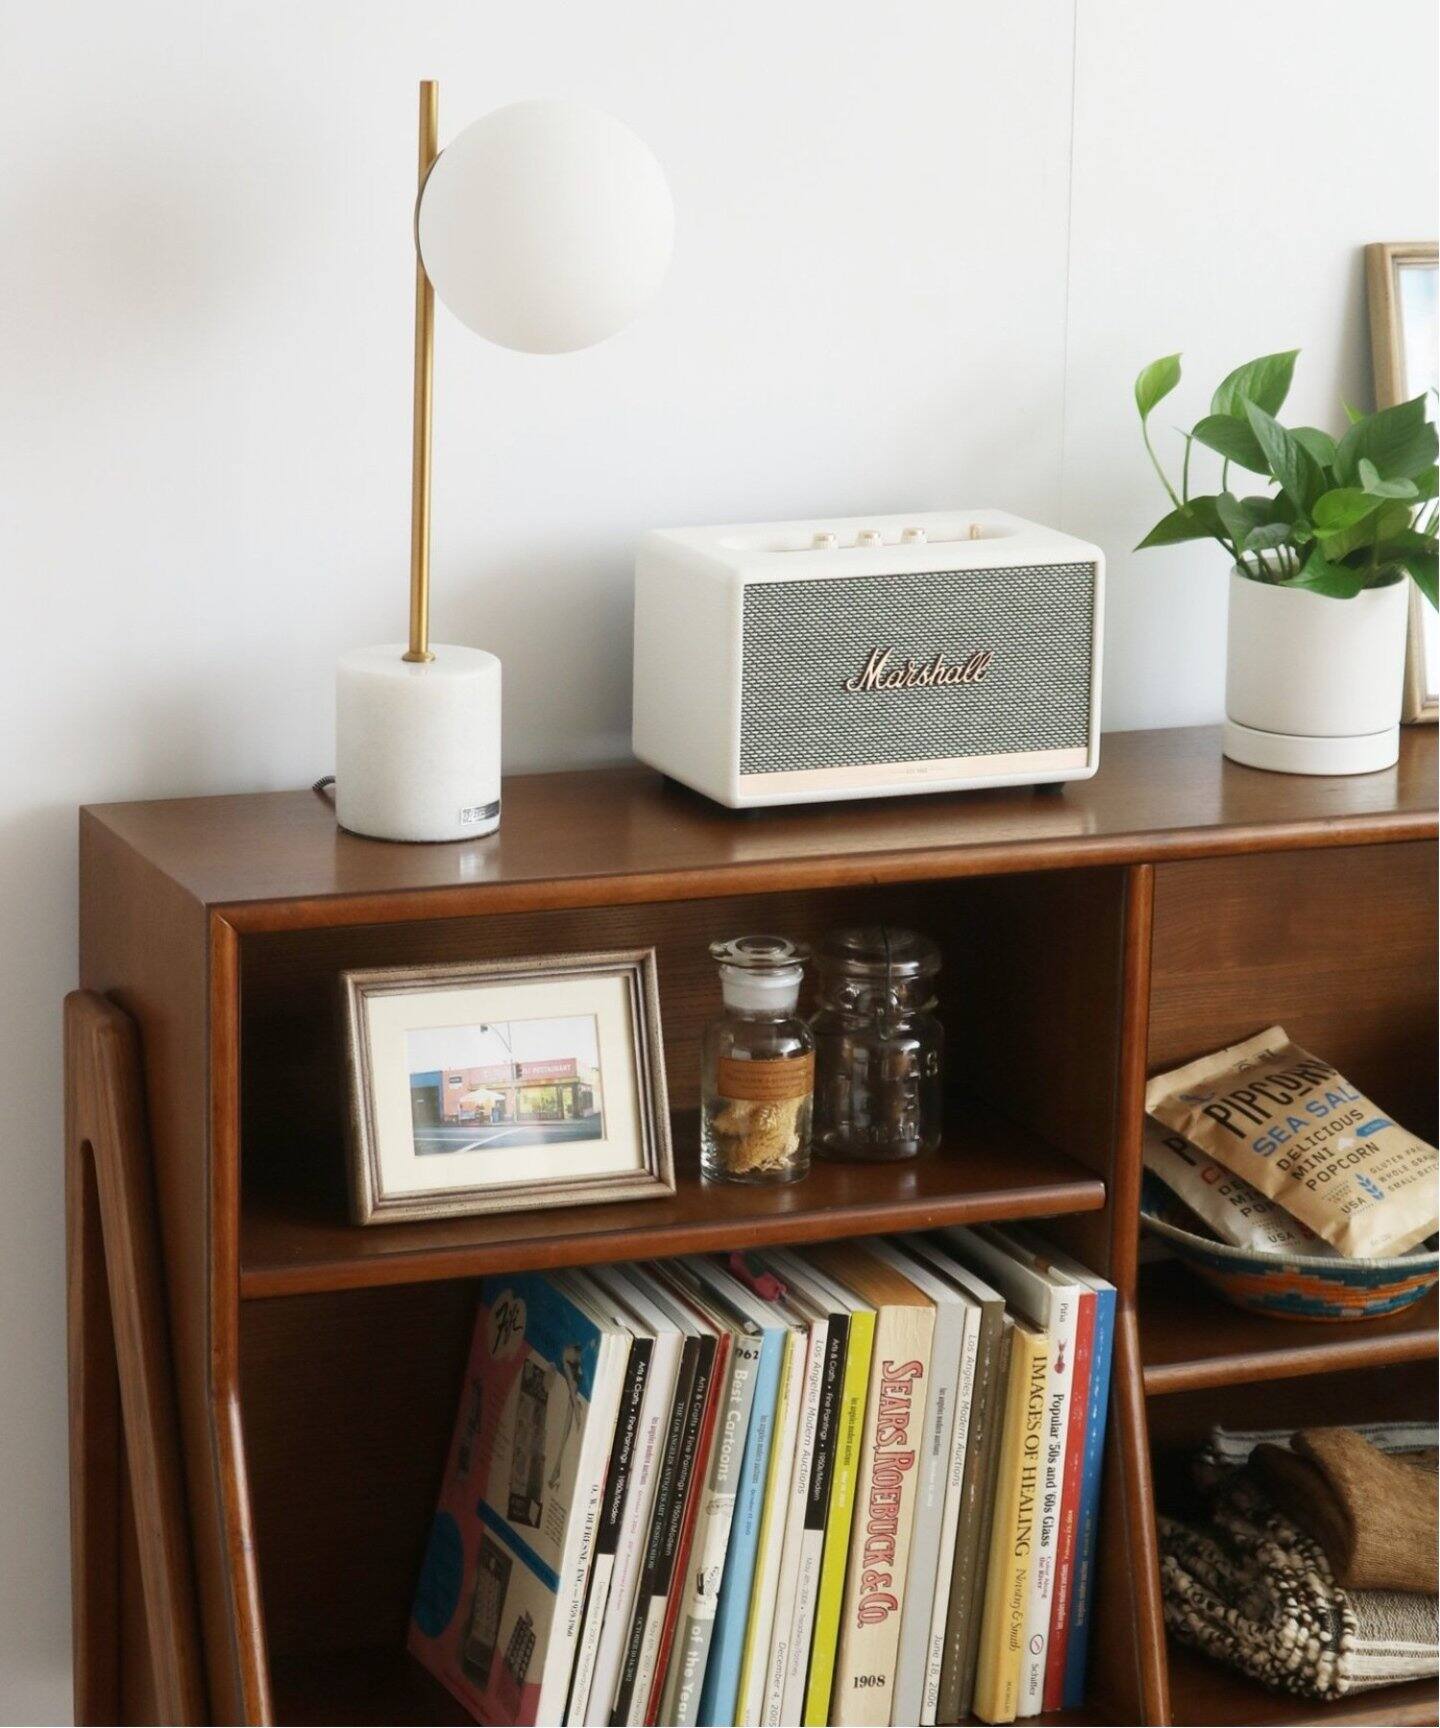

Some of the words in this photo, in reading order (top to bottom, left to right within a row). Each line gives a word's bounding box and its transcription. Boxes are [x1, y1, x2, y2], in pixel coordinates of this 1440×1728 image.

[846, 646, 994, 692] Marshall
[1202, 1059, 1337, 1139] PIPCORN
[1252, 1115, 1310, 1157] SEA
[1305, 1083, 1361, 1118] SAL
[1276, 1109, 1364, 1171] DELICIOUS
[1291, 1147, 1335, 1180] MINI
[1306, 1142, 1380, 1191] POPCORN
[1341, 1196, 1367, 1214] USA
[1268, 1231, 1296, 1244] USA
[814, 1341, 823, 1356] Los
[830, 1339, 838, 1350] Arts
[967, 1335, 976, 1351] Los
[637, 1362, 646, 1374] Arts
[807, 1363, 820, 1401] Angeles
[828, 1361, 836, 1381] Crafts
[961, 1356, 974, 1396] Angeles
[631, 1384, 642, 1404] Crafts
[697, 1376, 706, 1391] Arts
[730, 1370, 747, 1402] Best
[1026, 1356, 1048, 1432] IMAGES
[690, 1402, 701, 1426] Crafts
[824, 1393, 832, 1406] Fine
[627, 1416, 636, 1429] Fine
[804, 1407, 815, 1444] Modern
[820, 1409, 830, 1439] Paintings
[957, 1401, 969, 1438] Modern
[1046, 1393, 1065, 1437] Popular
[619, 1432, 632, 1462] Paintings
[686, 1437, 694, 1451] Fine
[718, 1410, 740, 1481] Cartoons
[1023, 1434, 1040, 1460] OF
[676, 1455, 690, 1490] Paintings
[798, 1451, 810, 1493] Auctions
[952, 1444, 964, 1486] Auctions
[1045, 1468, 1058, 1488] and
[862, 1450, 916, 1569] ROEBUCK
[1014, 1466, 1037, 1557] HEALING
[1039, 1516, 1054, 1546] Glass
[860, 1569, 893, 1594] &
[691, 1626, 704, 1641] of
[932, 1635, 941, 1657] June
[684, 1650, 699, 1677] the
[772, 1642, 787, 1687] December
[853, 1675, 886, 1689] 1908
[928, 1683, 937, 1706] 2006
[1027, 1664, 1039, 1695] Schiffer
[676, 1682, 693, 1720] Year
